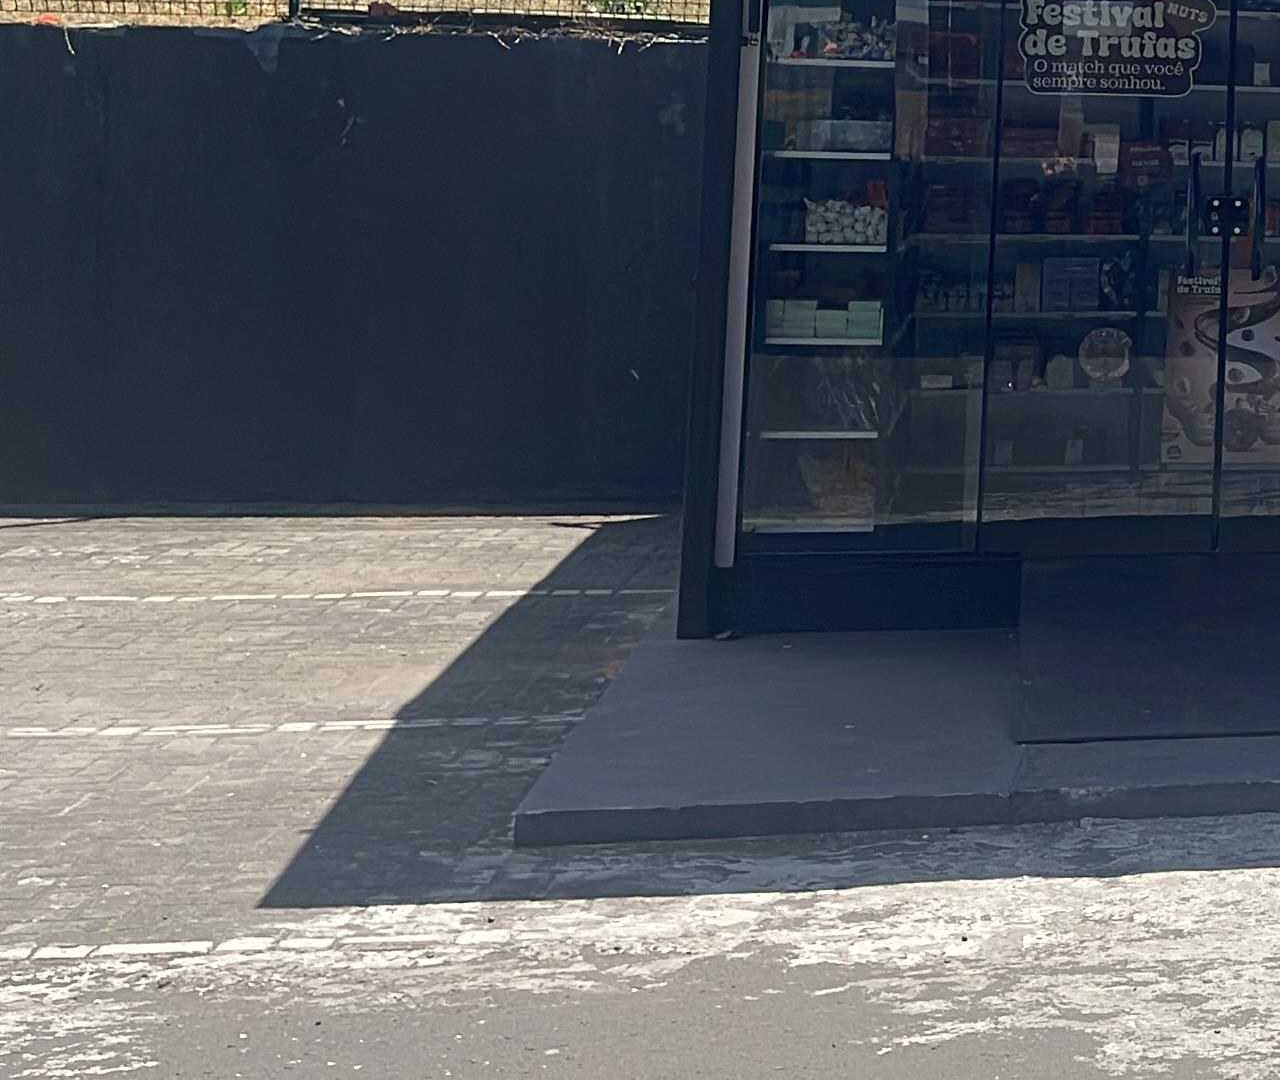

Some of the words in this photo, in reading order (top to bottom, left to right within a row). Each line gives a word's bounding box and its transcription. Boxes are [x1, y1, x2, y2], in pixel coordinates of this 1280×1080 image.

[1167, 1, 1208, 23] NUTS
[1024, 28, 1067, 56] de
[1077, 29, 1196, 59] Trufas
[1033, 58, 1048, 73] O
[1051, 59, 1105, 74] match
[1108, 63, 1142, 78] que
[1145, 62, 1184, 77] você
[1032, 76, 1096, 92] sempre
[1100, 76, 1166, 91] sonhou.
